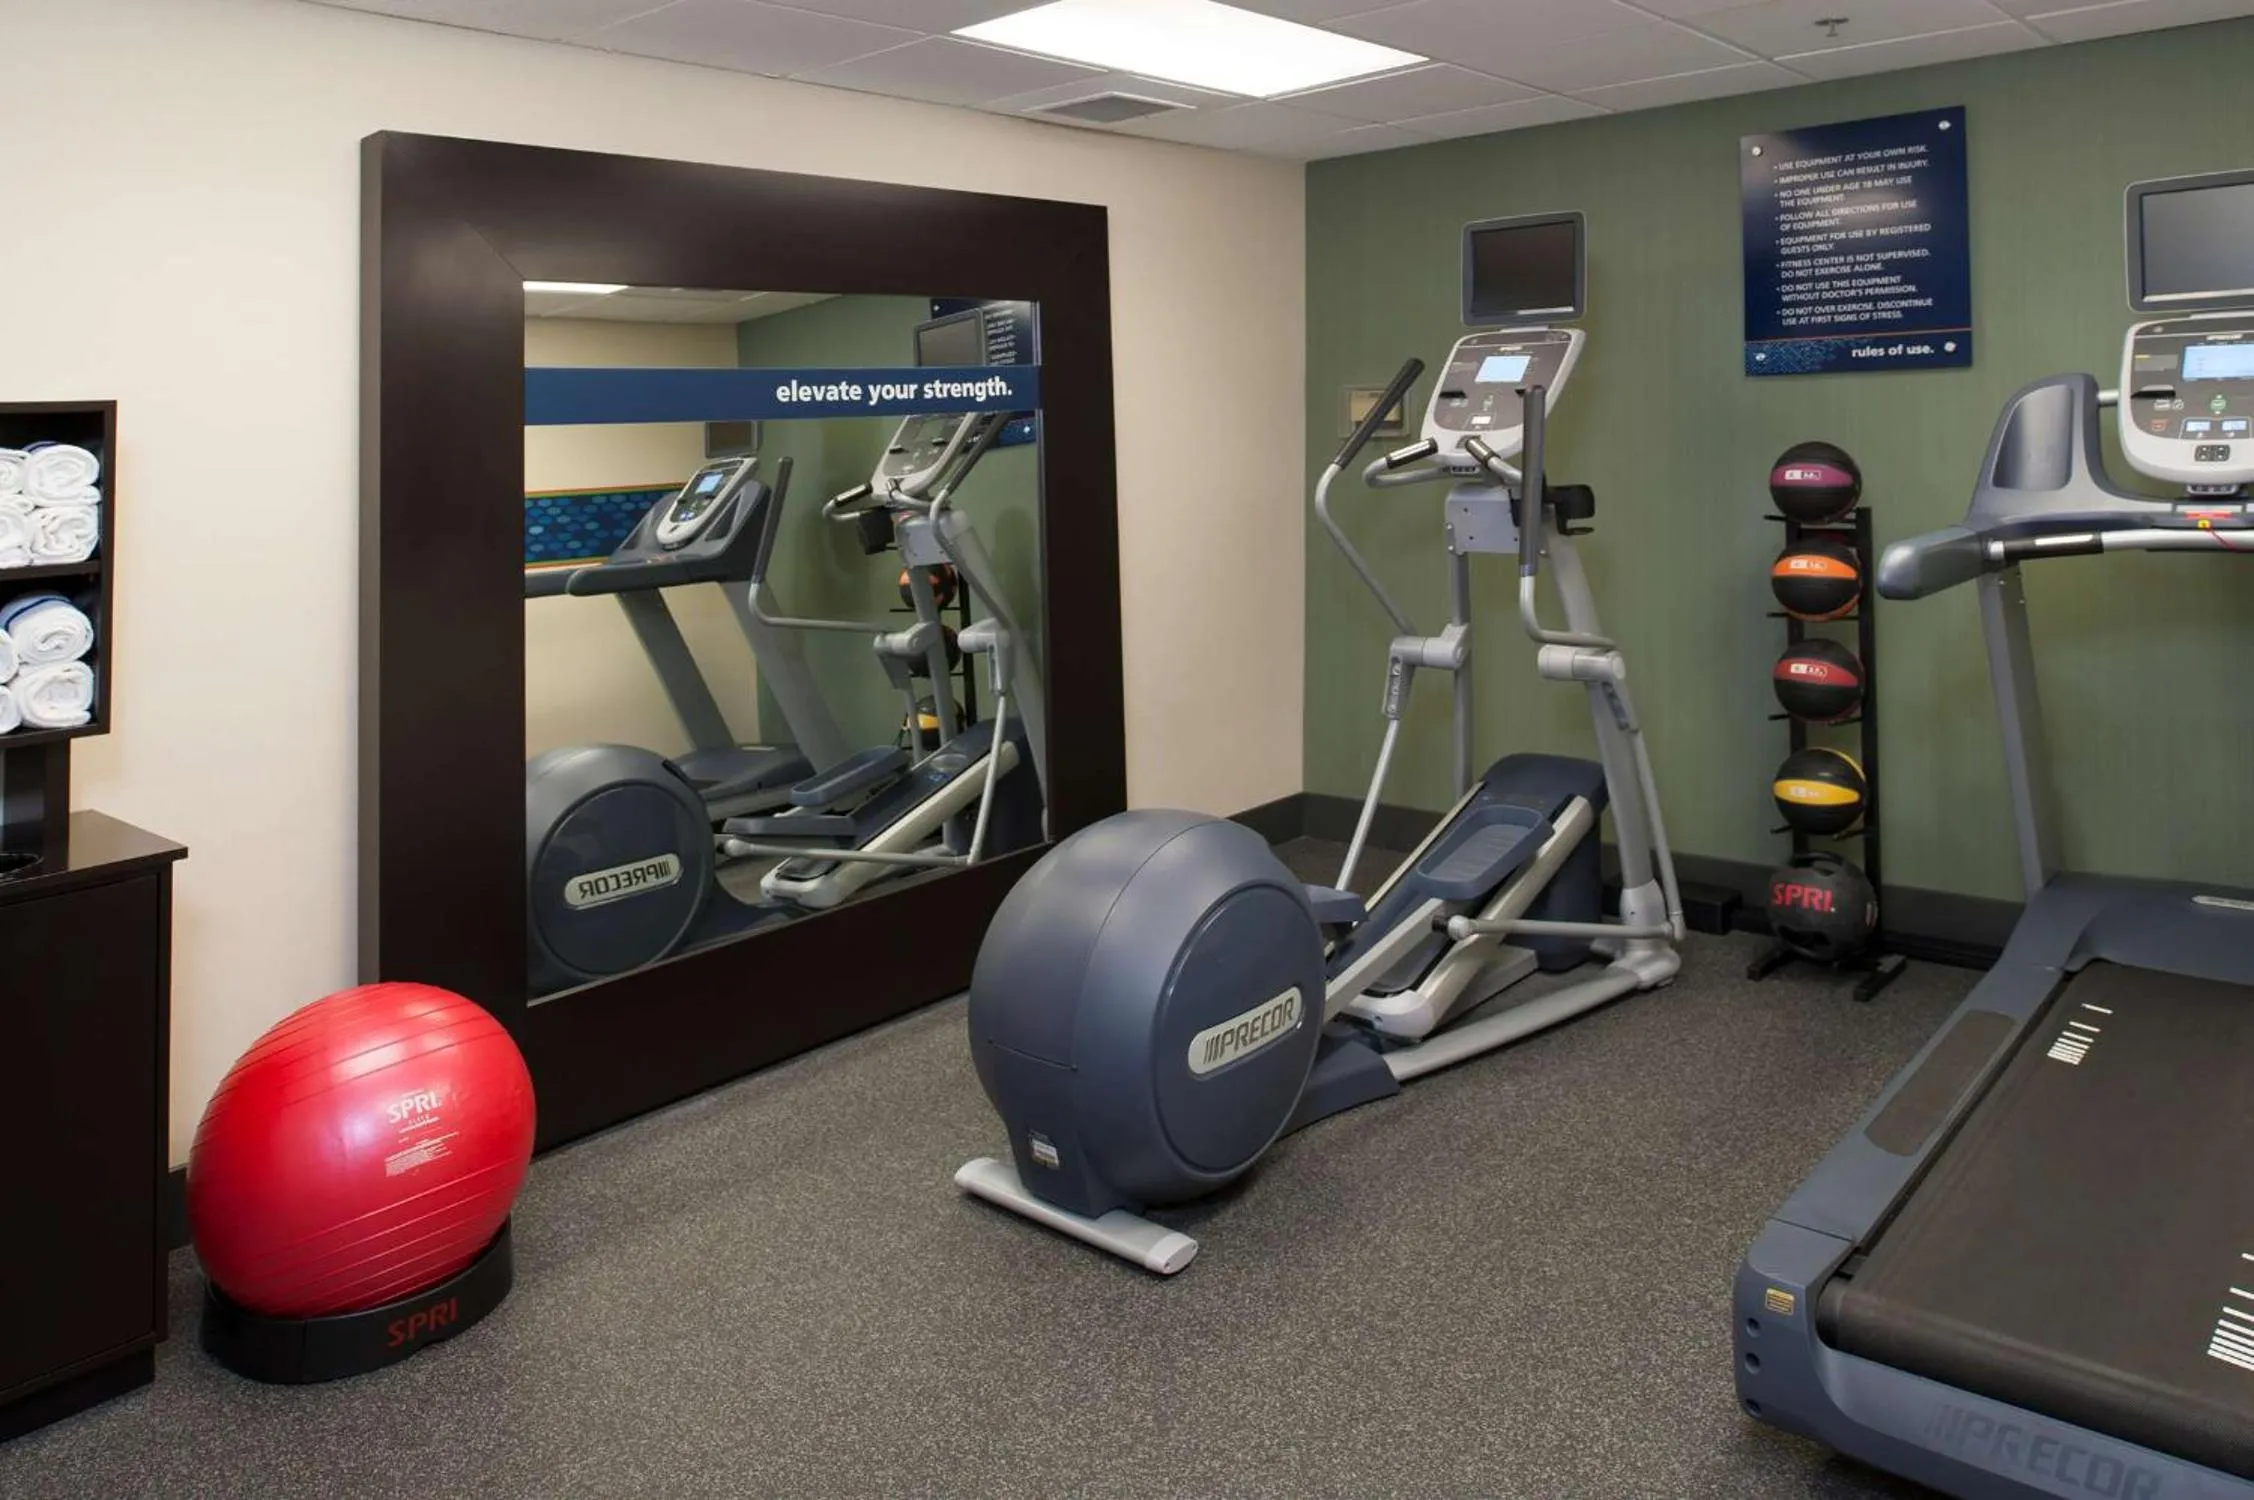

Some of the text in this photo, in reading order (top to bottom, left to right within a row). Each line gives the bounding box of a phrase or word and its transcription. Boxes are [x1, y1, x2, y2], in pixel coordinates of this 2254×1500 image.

[1795, 156, 1842, 169] EQUIPMENT
[1844, 154, 1855, 162] AT
[1857, 151, 1881, 160] YOUR
[1883, 148, 1905, 157] OWN
[1779, 173, 1818, 184] IMPROPER
[1820, 170, 1835, 178] USE
[1837, 168, 1854, 177] CAN
[1856, 165, 1884, 174] RESULT
[1794, 188, 1810, 196] ONE
[1813, 184, 1841, 194] UNDER
[1843, 181, 1859, 190] AGE
[1874, 178, 1894, 186] MAY
[1896, 176, 1912, 184] USE
[1780, 199, 1794, 207] THE
[1780, 200, 1917, 221] FOLLOW ALL DIRECTIONS FOR USE
[1780, 224, 1931, 245] EQUIPMENT FOR USE BY REGISTERED
[1781, 259, 1811, 268] FITNESS
[1813, 256, 1844, 266] CENTER
[1847, 255, 1854, 263] IS
[1856, 253, 1874, 261] NOT
[1815, 265, 1850, 275] EXERCISE
[1781, 284, 1794, 292] DO
[1796, 283, 1813, 291] NOT
[1815, 281, 1829, 289] USE
[1852, 276, 1901, 286] EQUIPMENT
[1782, 292, 1819, 301] WITHOUT
[1822, 289, 1863, 298] DOCTOR'S
[1782, 308, 1794, 316] DO
[1796, 306, 1812, 314] NOT
[1814, 304, 1835, 313] OVER
[1877, 298, 1933, 309] DISCONTINUE
[1812, 314, 1832, 323] FIRST
[1834, 313, 1857, 322] SIGNS
[1859, 311, 1871, 319] OF
[1852, 344, 1935, 358] rules of use.
[776, 376, 1013, 405] elevate your strength.
[1216, 997, 1294, 1060] PRECOR
[387, 1297, 458, 1347] SPRI
